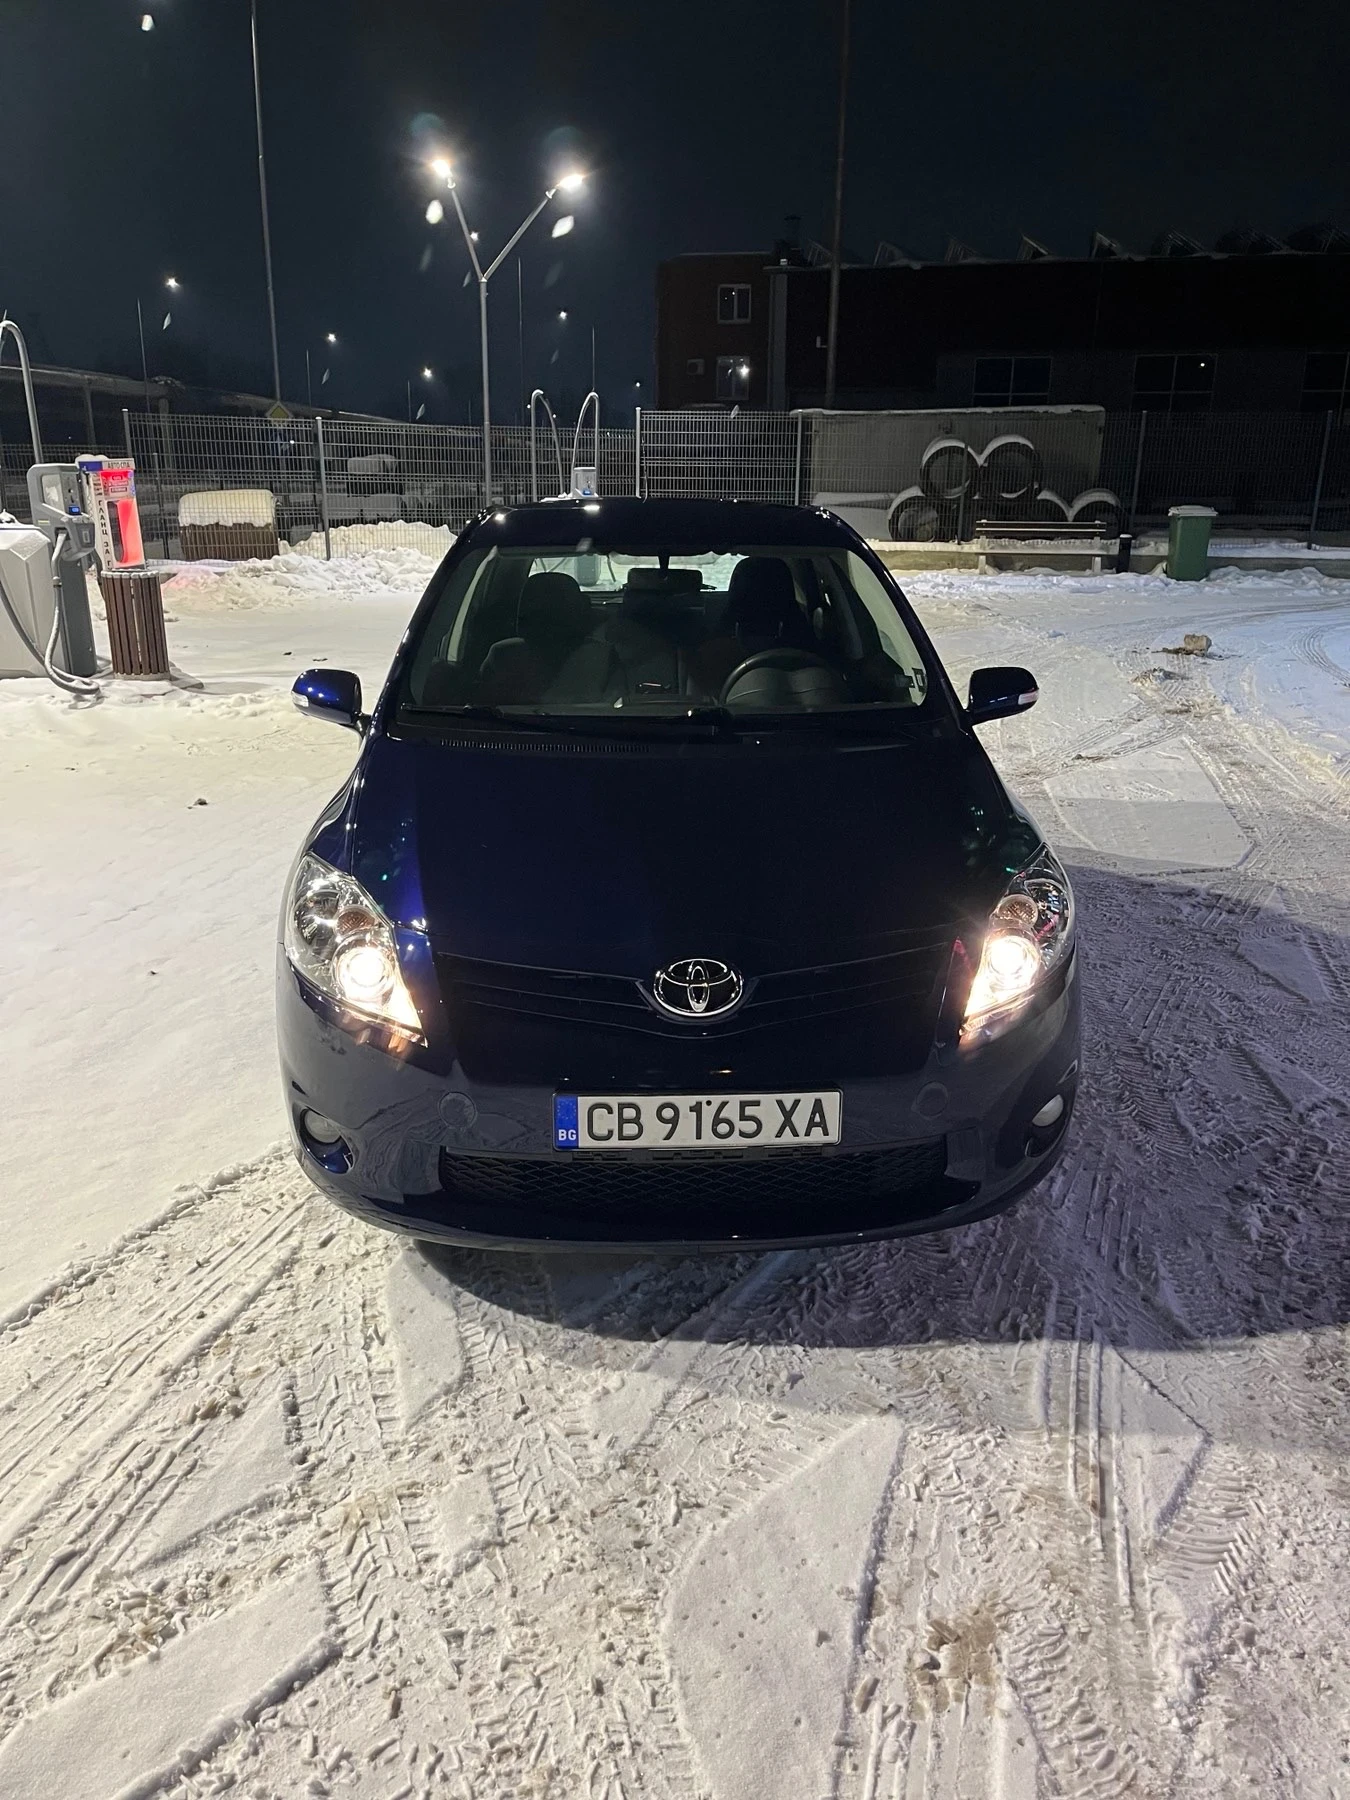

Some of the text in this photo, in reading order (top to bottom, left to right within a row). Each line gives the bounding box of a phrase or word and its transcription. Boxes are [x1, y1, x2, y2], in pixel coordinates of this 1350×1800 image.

[586, 1098, 830, 1142] CB 9165 XA
[558, 1129, 577, 1141] BG
